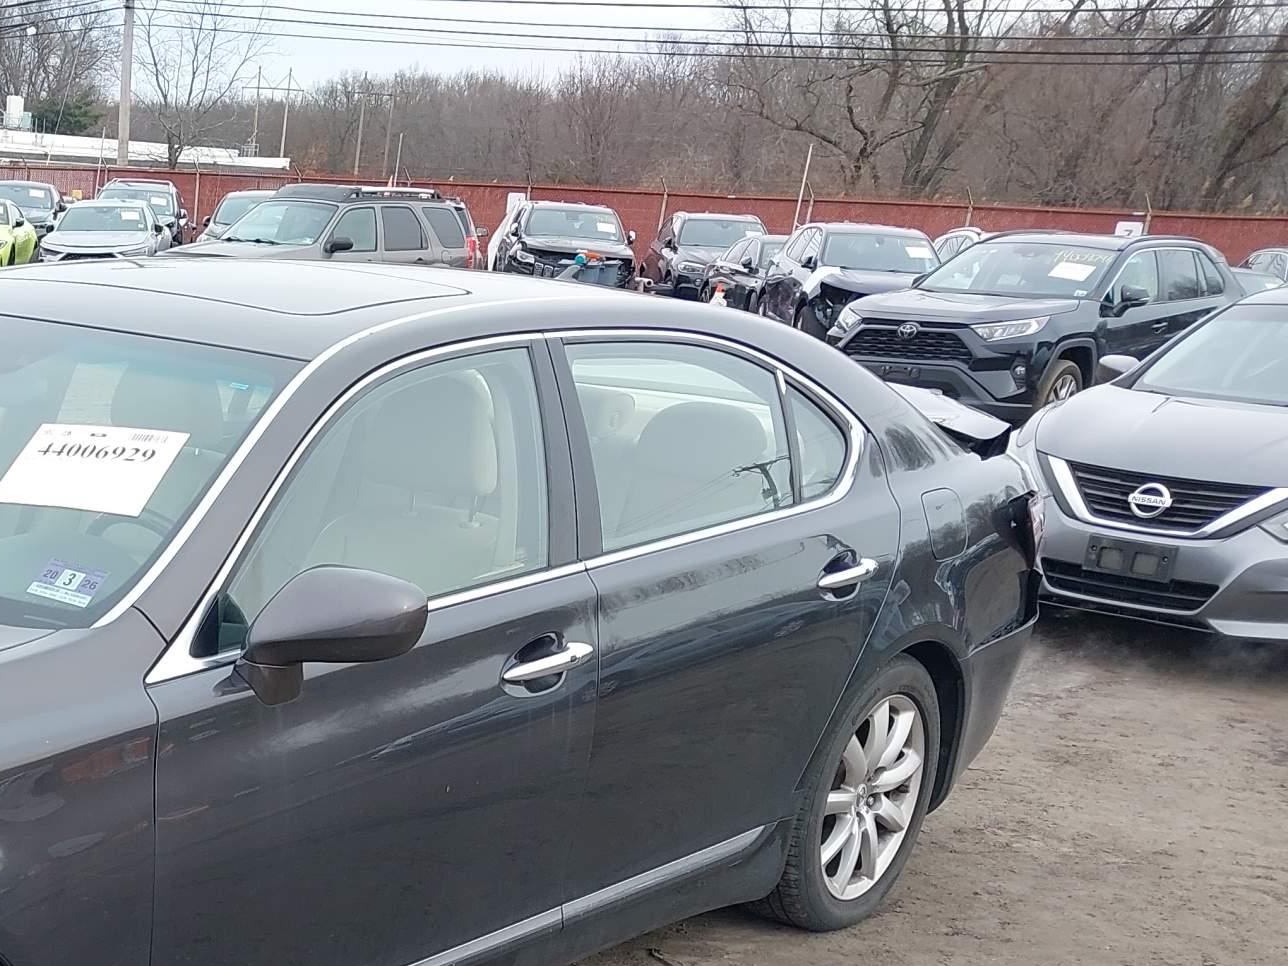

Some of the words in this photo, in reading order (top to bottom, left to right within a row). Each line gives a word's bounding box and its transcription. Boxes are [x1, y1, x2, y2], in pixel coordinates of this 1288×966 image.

[37, 442, 156, 462] 44006929
[1132, 495, 1166, 505] NISSAN
[43, 569, 58, 579] 20
[63, 573, 76, 586] 3
[82, 579, 99, 590] 26
